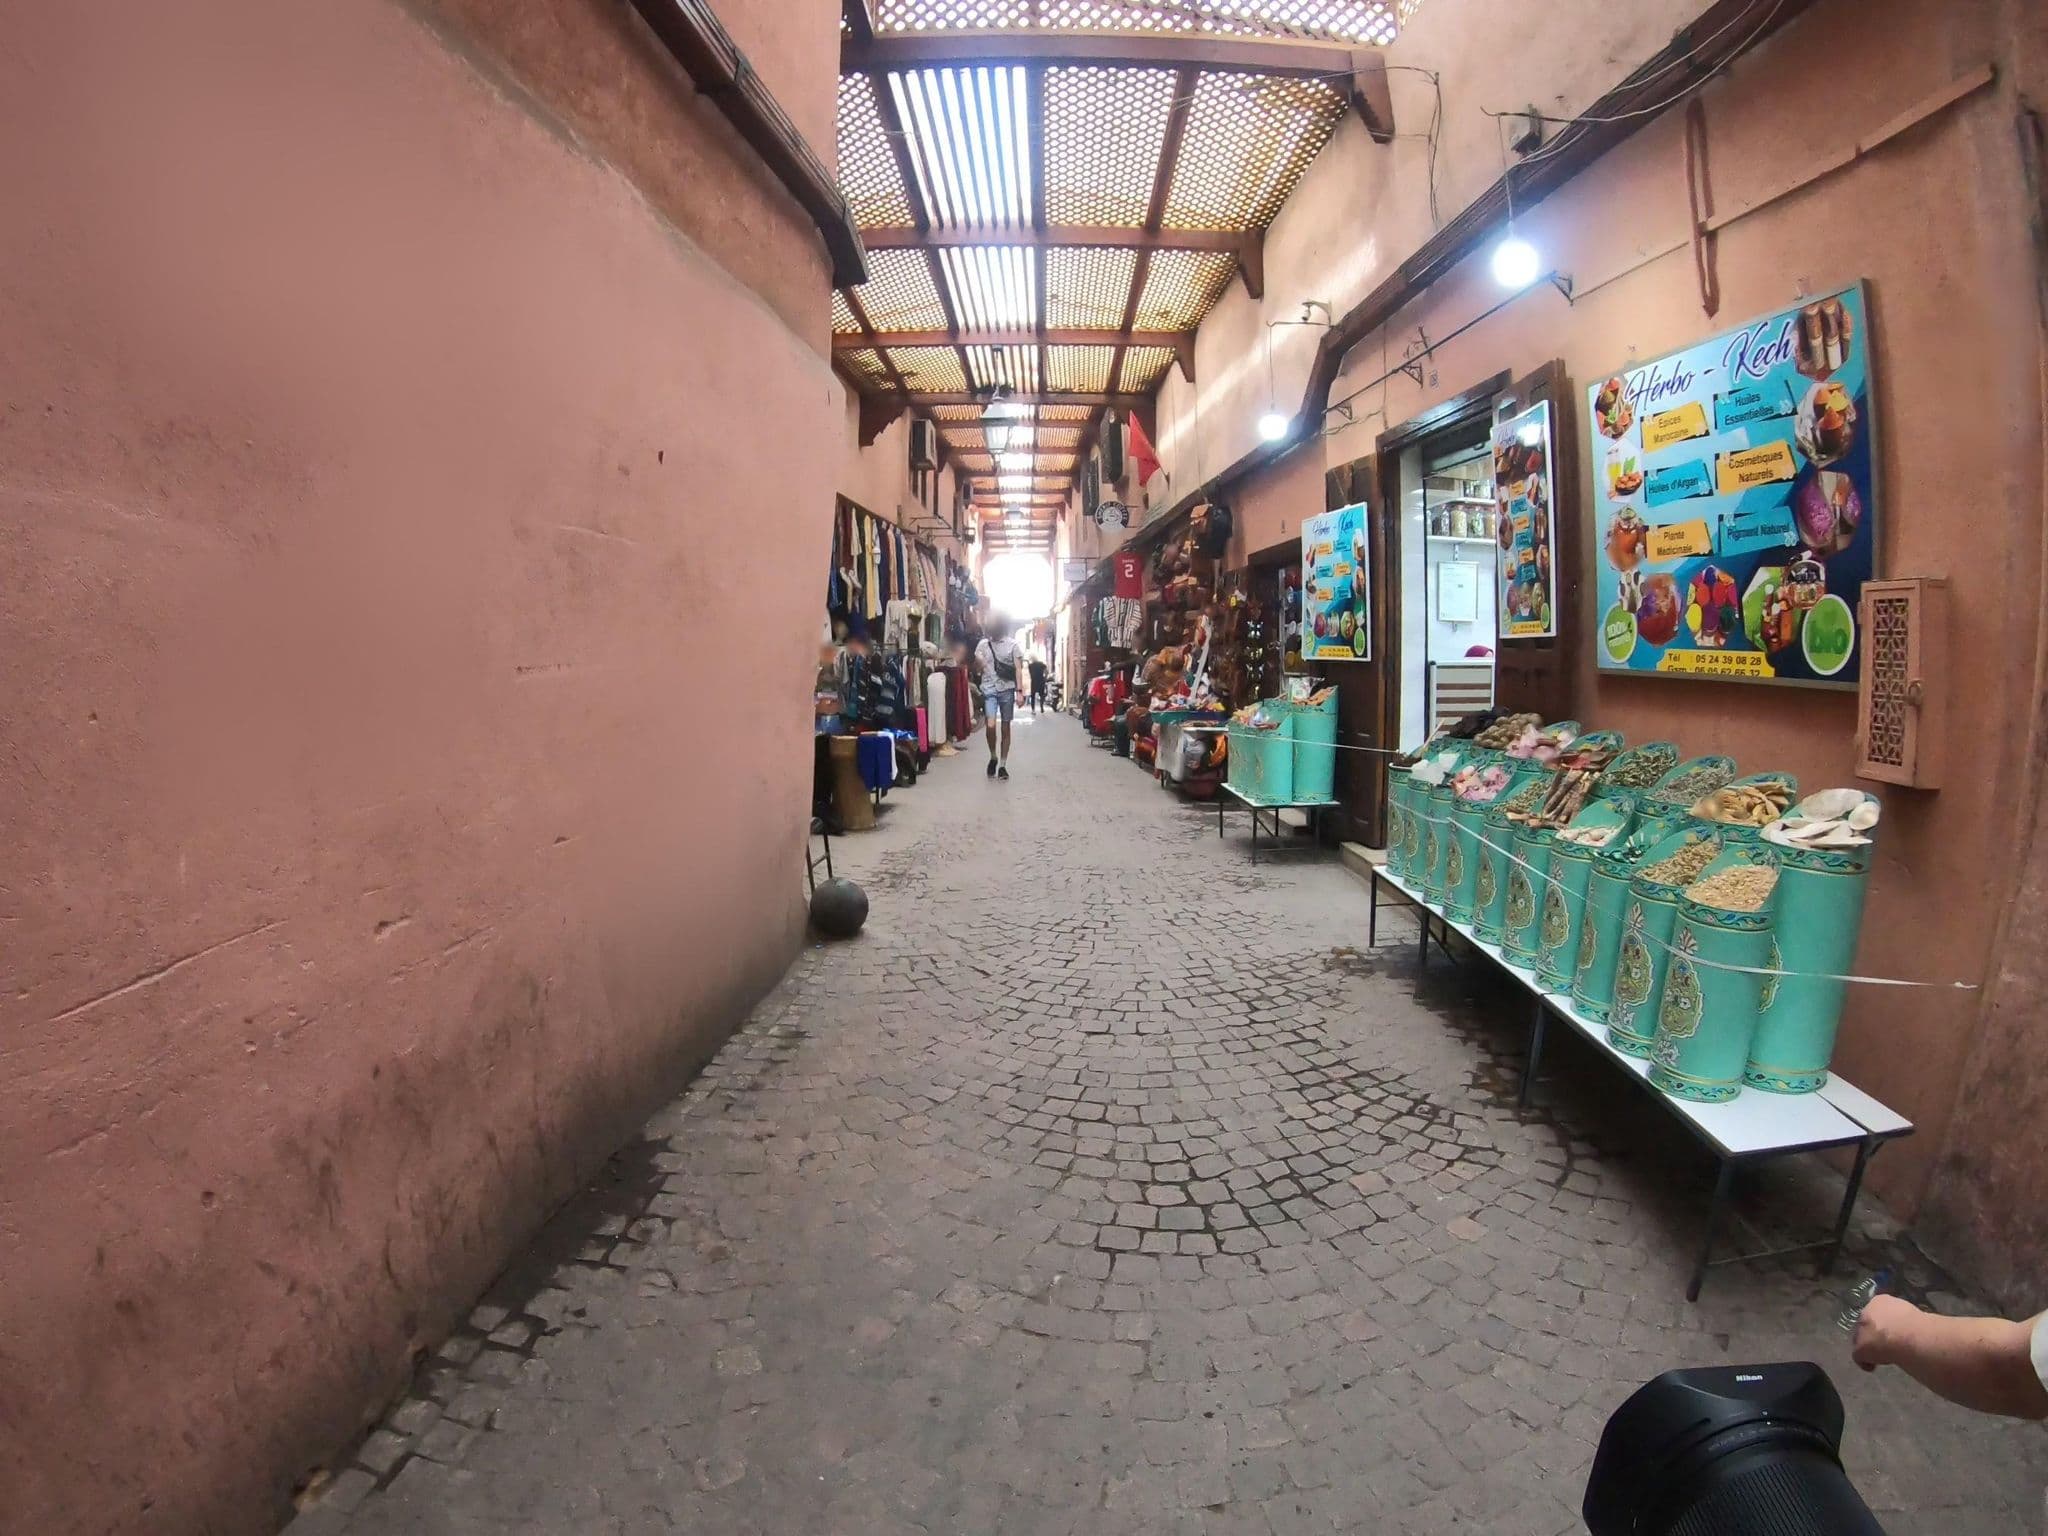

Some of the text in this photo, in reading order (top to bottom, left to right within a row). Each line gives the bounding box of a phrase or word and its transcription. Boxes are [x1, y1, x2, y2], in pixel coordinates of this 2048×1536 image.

[1722, 322, 1790, 381] Kech
[1725, 406, 1775, 425] Essentielles
[1739, 468, 1774, 482] Naturels
[1671, 477, 1699, 489] d'Argan
[1124, 564, 1134, 578] 2
[1696, 654, 1706, 663] 05
[1709, 655, 1719, 664] 24
[1722, 655, 1733, 665] 39
[1750, 656, 1762, 666] 28
